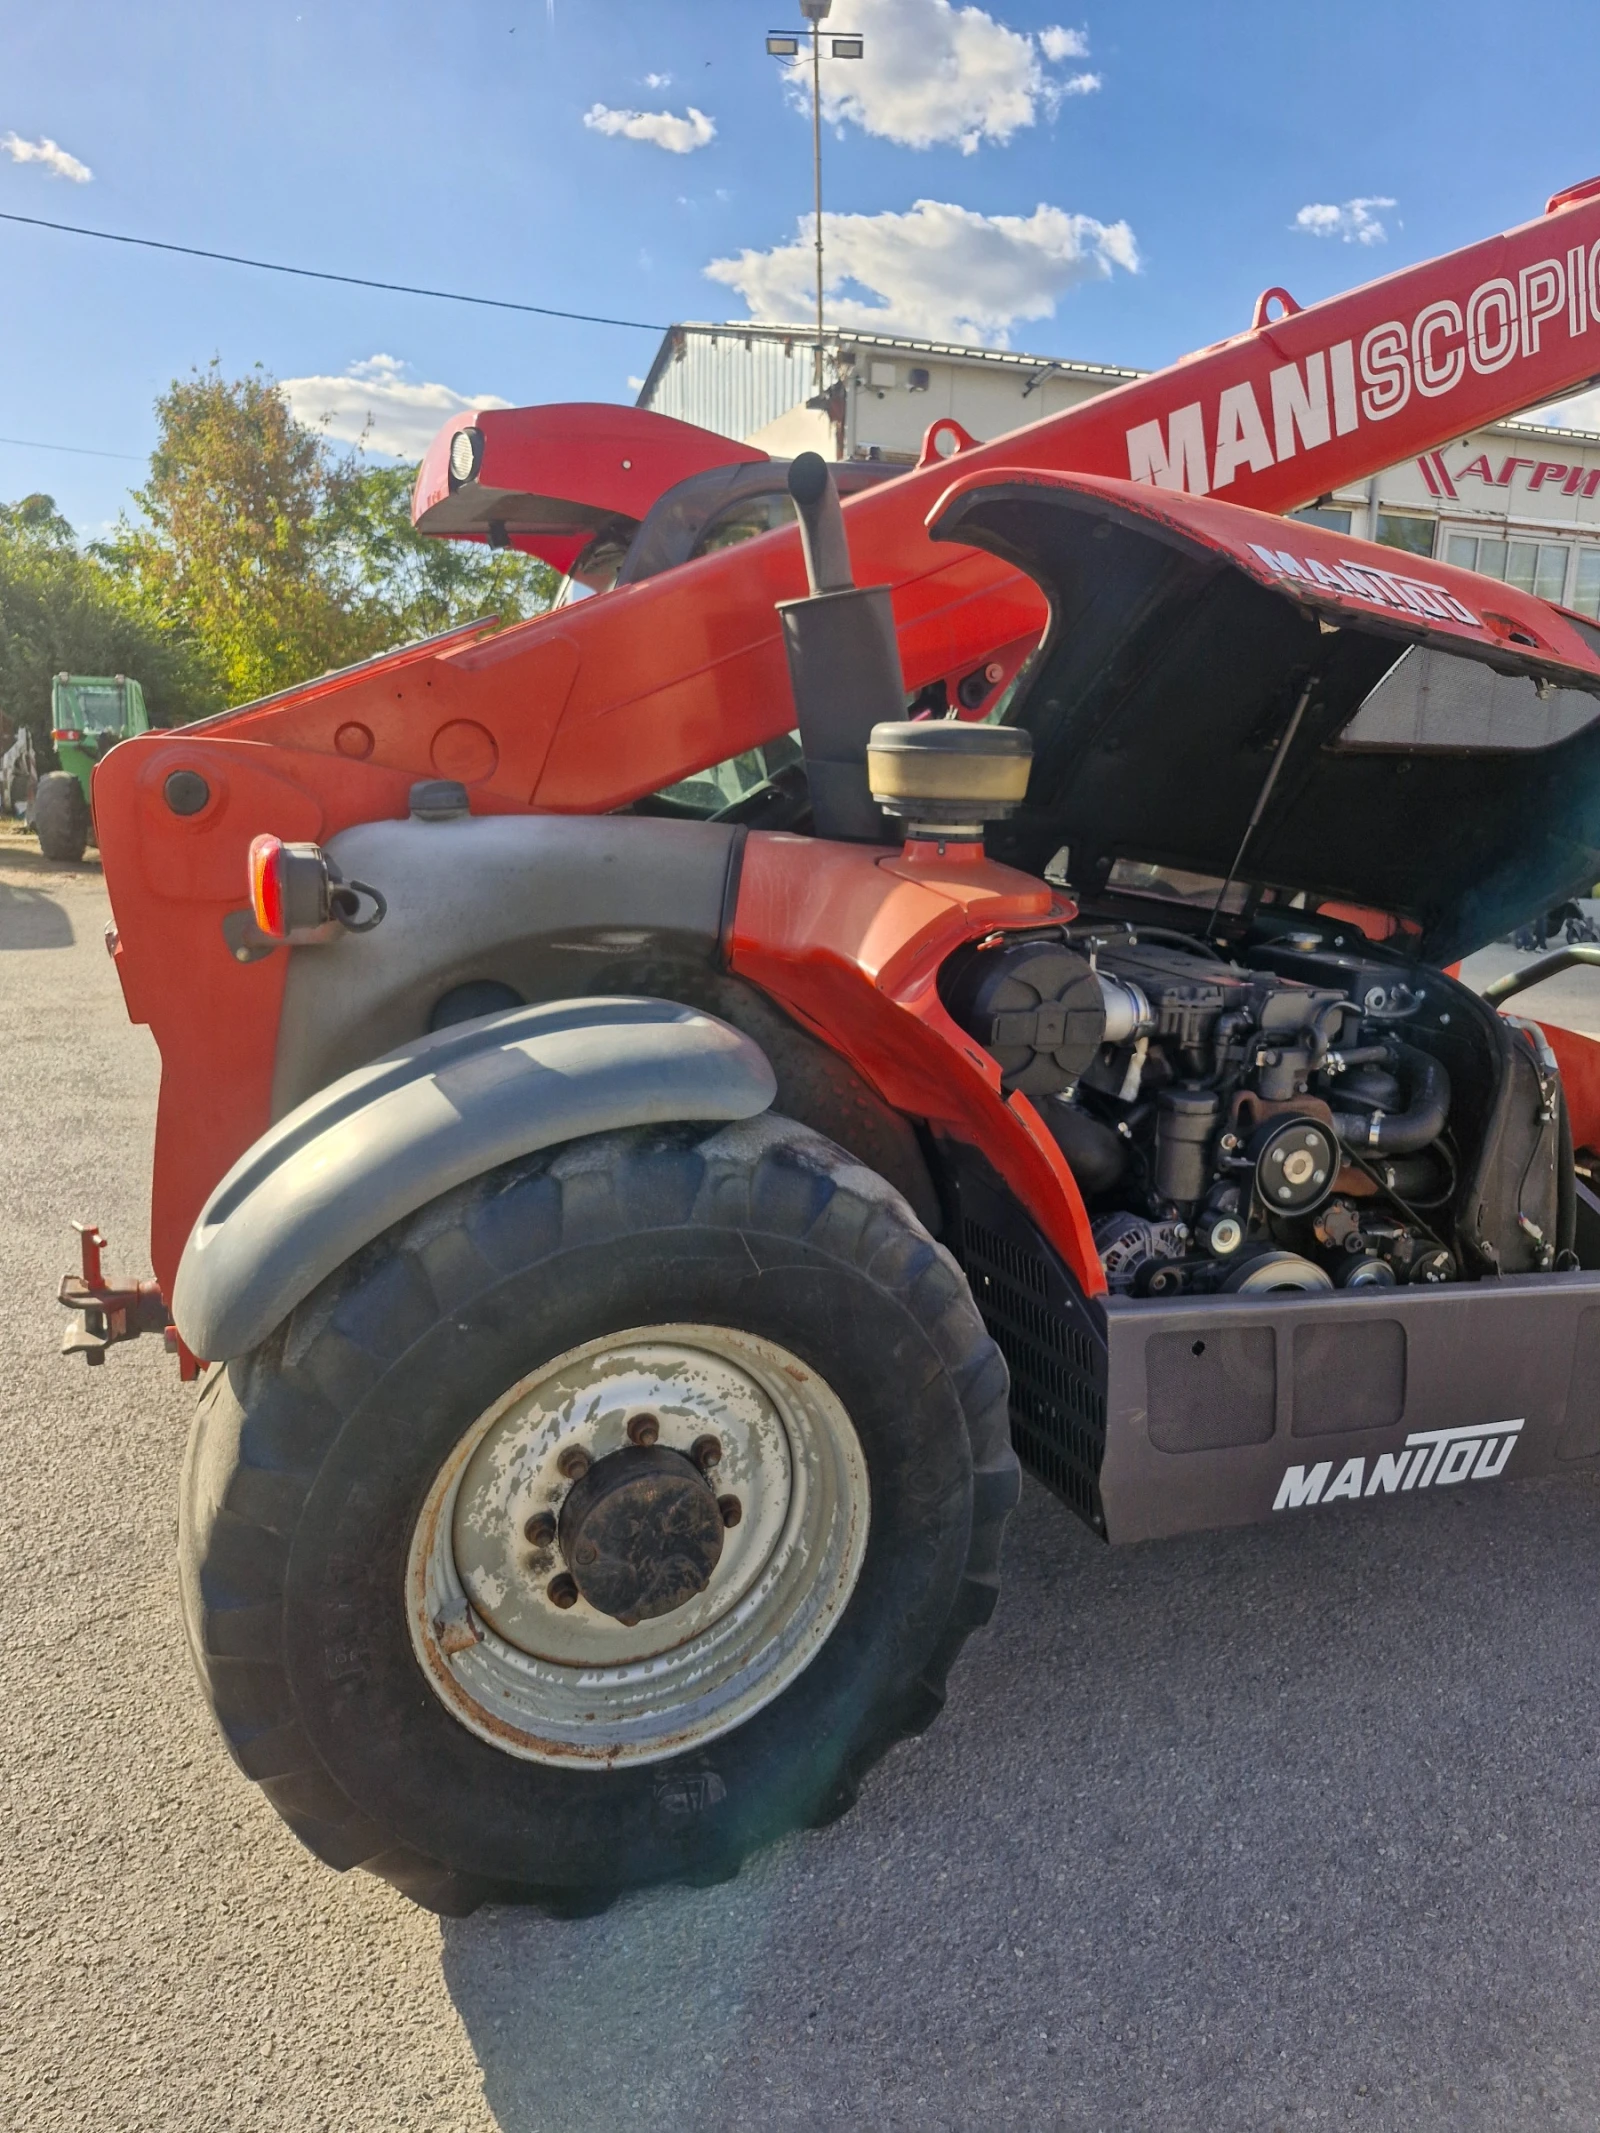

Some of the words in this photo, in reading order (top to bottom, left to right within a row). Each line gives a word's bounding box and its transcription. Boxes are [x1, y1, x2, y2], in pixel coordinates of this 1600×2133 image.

[1126, 239, 1600, 496] MANISCOPI
[1247, 542, 1481, 625] MANITOU
[1272, 1418, 1525, 1510] MANITOU
